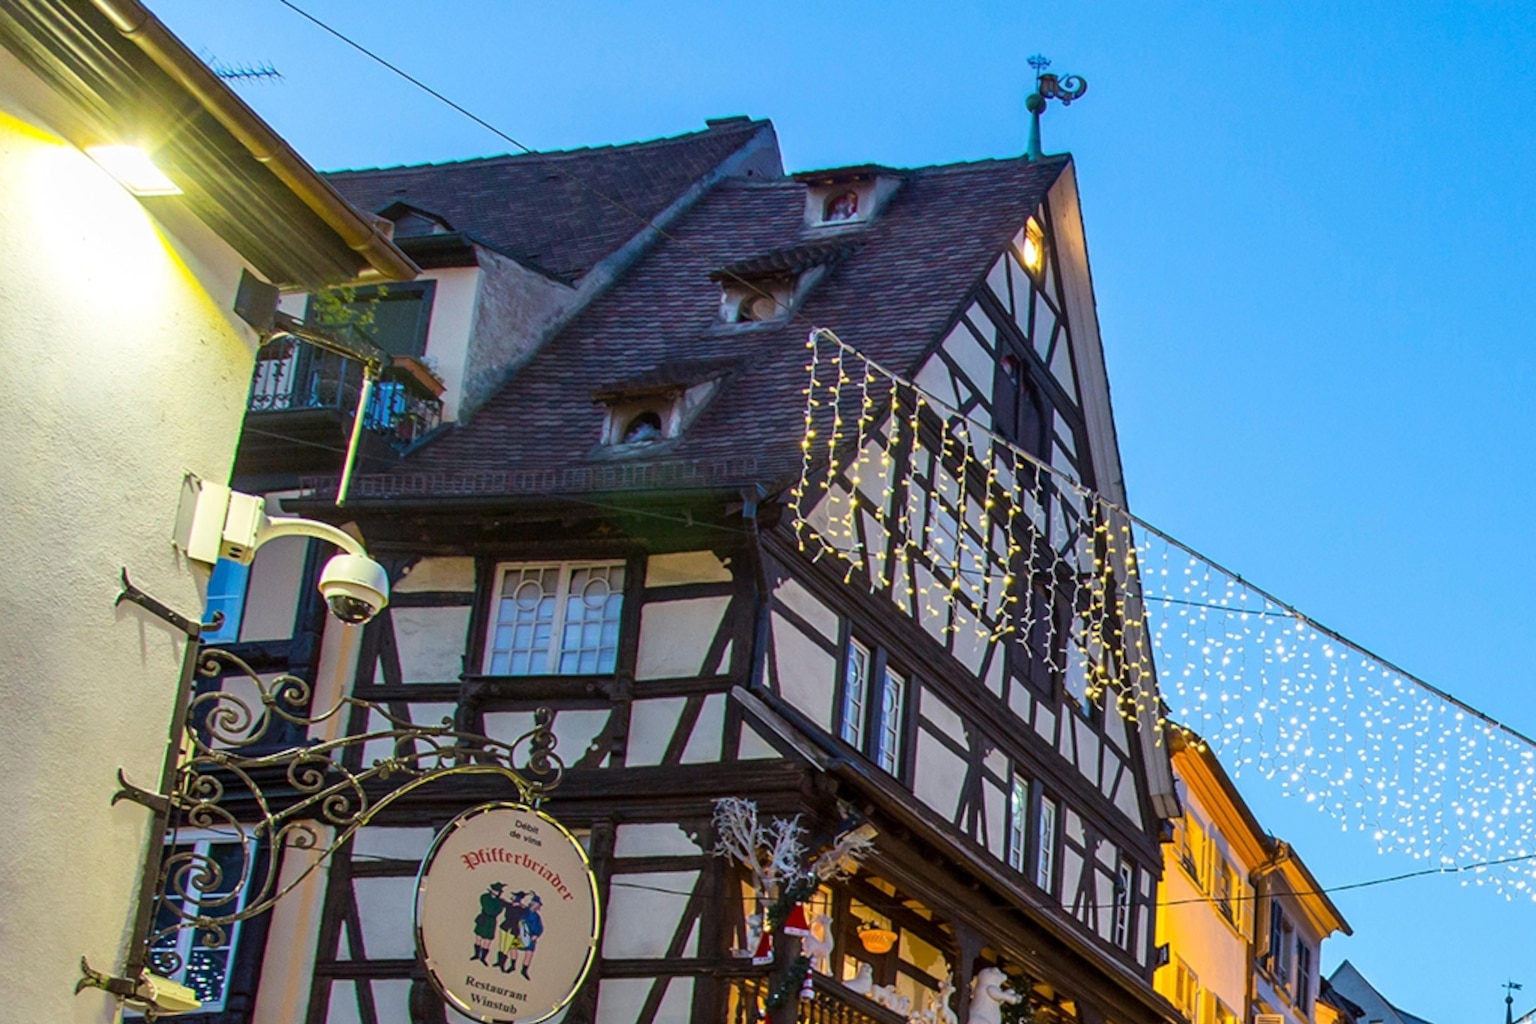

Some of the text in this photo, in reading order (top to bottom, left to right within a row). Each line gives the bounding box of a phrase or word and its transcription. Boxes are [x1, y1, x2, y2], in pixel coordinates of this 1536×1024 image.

[509, 829, 542, 848] de vins
[514, 819, 540, 835] Débit
[461, 847, 575, 902] Pfifferbriader
[465, 975, 529, 1002] Restaurant
[470, 992, 518, 1015] Winstub
